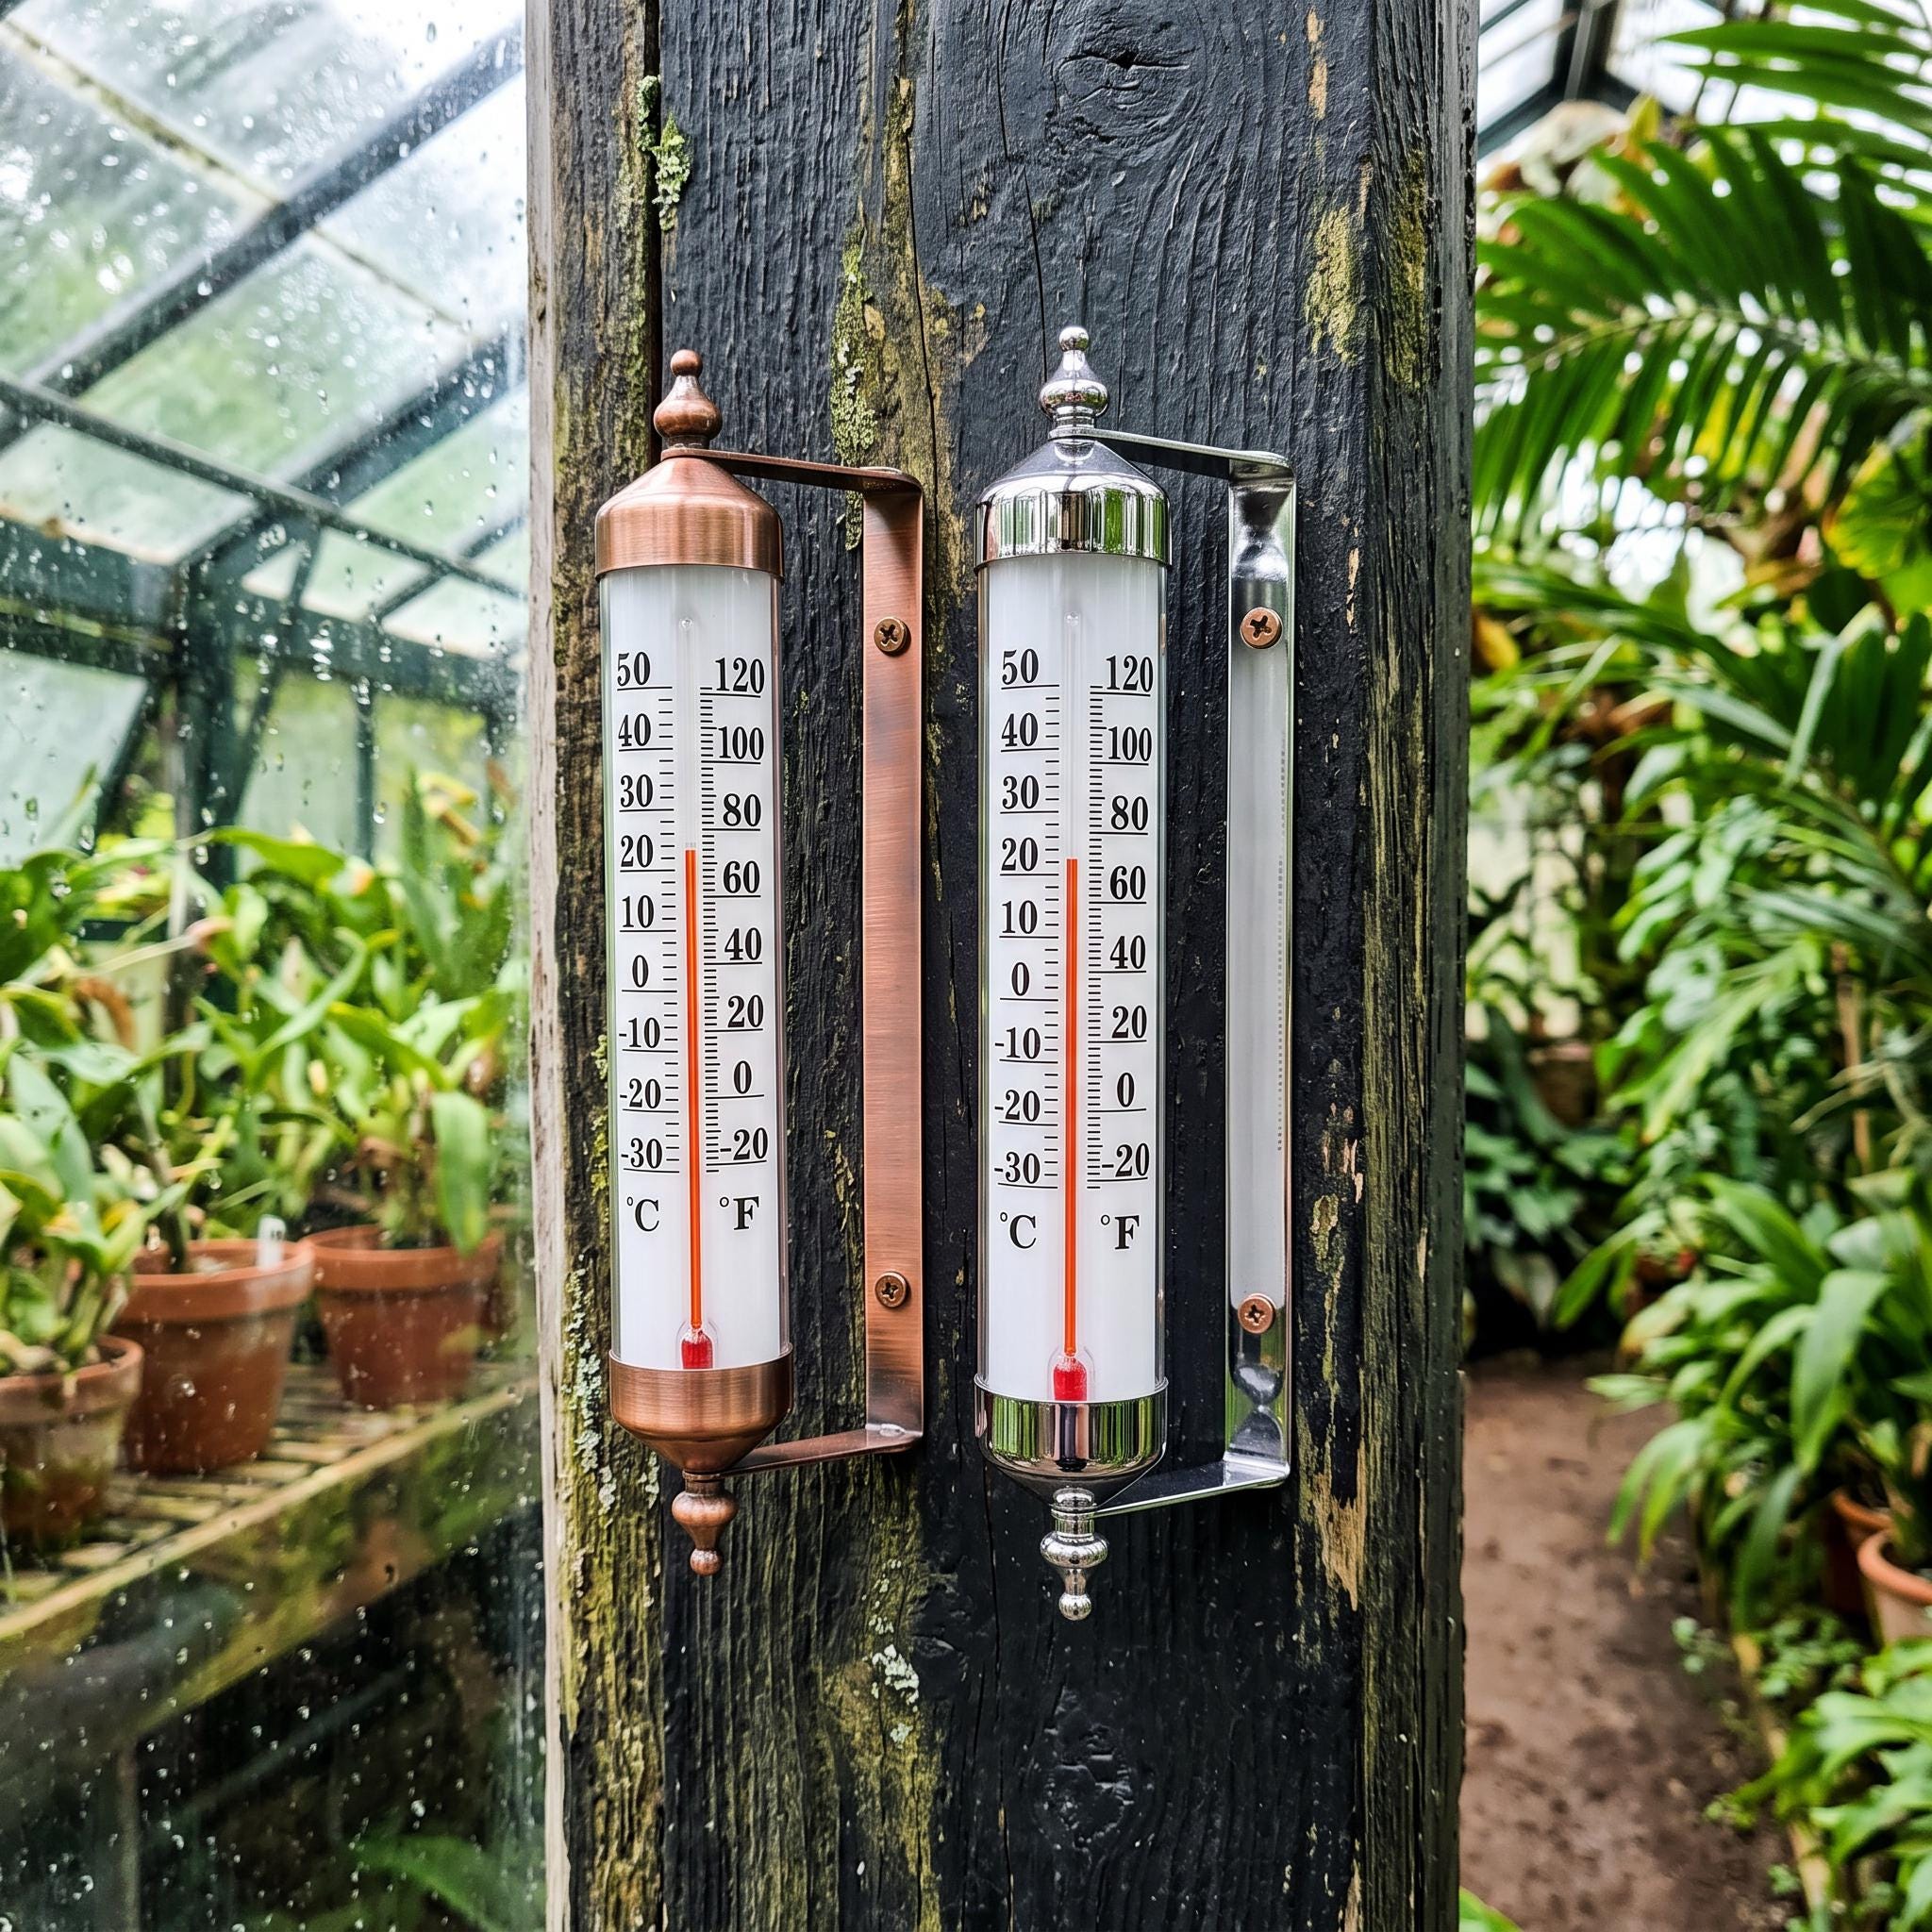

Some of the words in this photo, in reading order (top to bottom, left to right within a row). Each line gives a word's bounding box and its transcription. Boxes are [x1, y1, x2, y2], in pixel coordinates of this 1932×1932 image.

[617, 652, 651, 687] 50
[715, 658, 765, 694] 120
[1002, 649, 1039, 685] 50
[1106, 656, 1154, 692] 120
[618, 713, 652, 747] 40
[718, 725, 764, 760] 100
[1001, 713, 1039, 747] 40
[1108, 726, 1153, 762] 100
[620, 774, 654, 808] 30
[1002, 775, 1040, 809] 30
[723, 793, 761, 827] 80
[1110, 795, 1149, 831] 80
[620, 835, 654, 868] 20
[1001, 837, 1039, 872] 20
[723, 860, 760, 894] 60
[1109, 865, 1146, 900] 60
[622, 895, 655, 928] 10
[1002, 900, 1038, 934] 10
[724, 927, 762, 961] 40
[1109, 935, 1146, 970] 40
[632, 955, 649, 989] 0
[1011, 961, 1030, 996] 0
[727, 994, 764, 1028] 20
[1111, 1005, 1147, 1039] 20
[619, 1017, 660, 1049] -10
[994, 1027, 1041, 1059] -10
[620, 1078, 661, 1109] -20
[733, 1060, 752, 1094] 0
[1116, 1072, 1135, 1108] 0
[994, 1090, 1041, 1122] -20
[621, 1138, 663, 1170] -30
[720, 1127, 769, 1161] -20
[1101, 1142, 1150, 1177] -20
[994, 1151, 1041, 1184] -30
[626, 1196, 659, 1232] °C
[719, 1195, 760, 1230] °F
[999, 1212, 1037, 1249] °C
[1100, 1214, 1140, 1250] °F
